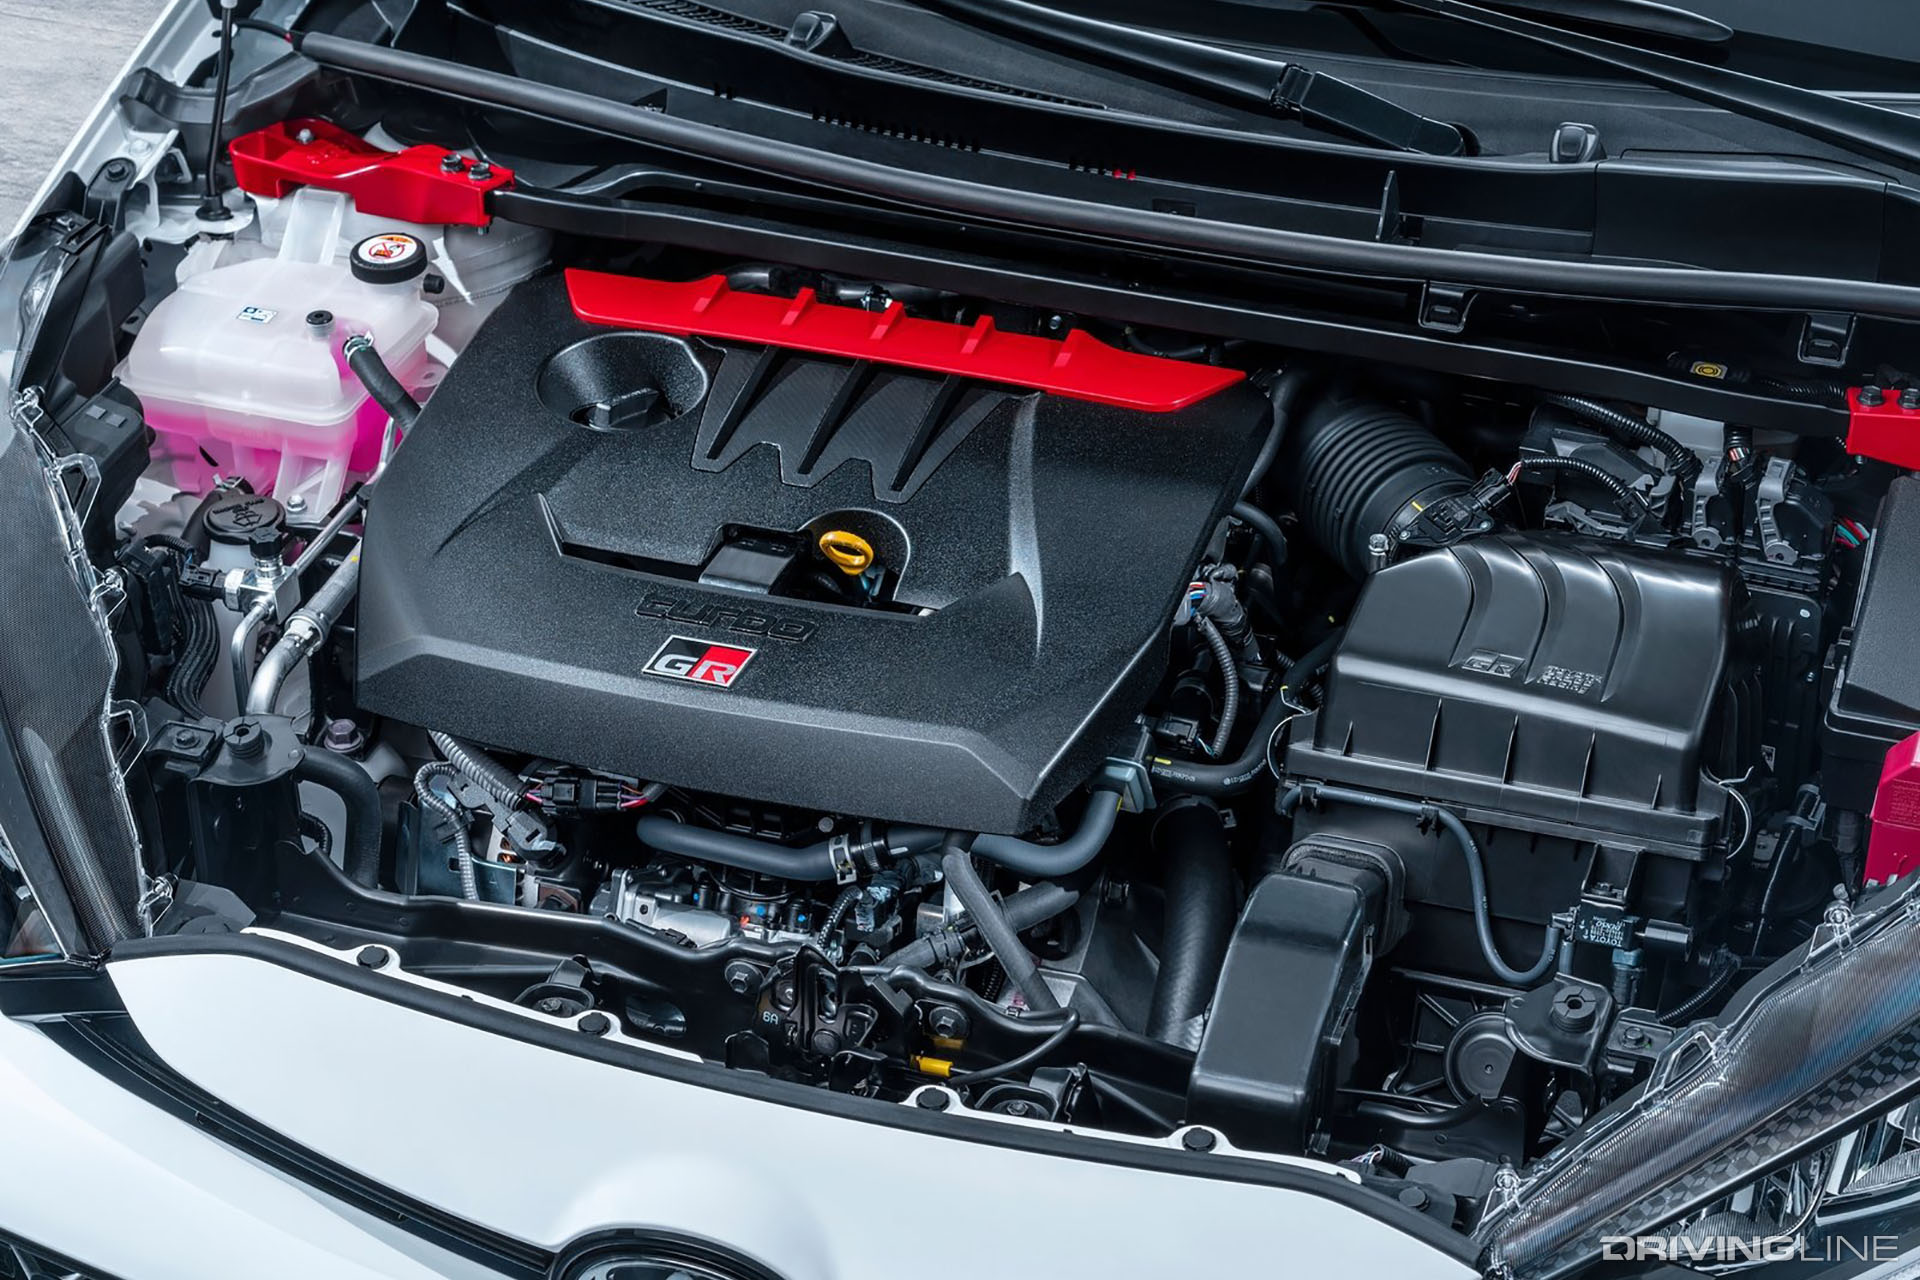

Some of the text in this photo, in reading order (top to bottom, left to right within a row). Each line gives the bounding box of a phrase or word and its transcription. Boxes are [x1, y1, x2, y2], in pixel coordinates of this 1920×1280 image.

[654, 654, 738, 684] GR
[1464, 656, 1516, 678] GR
[1590, 934, 1622, 947] TOYOTA
[763, 1011, 779, 1025] 6A
